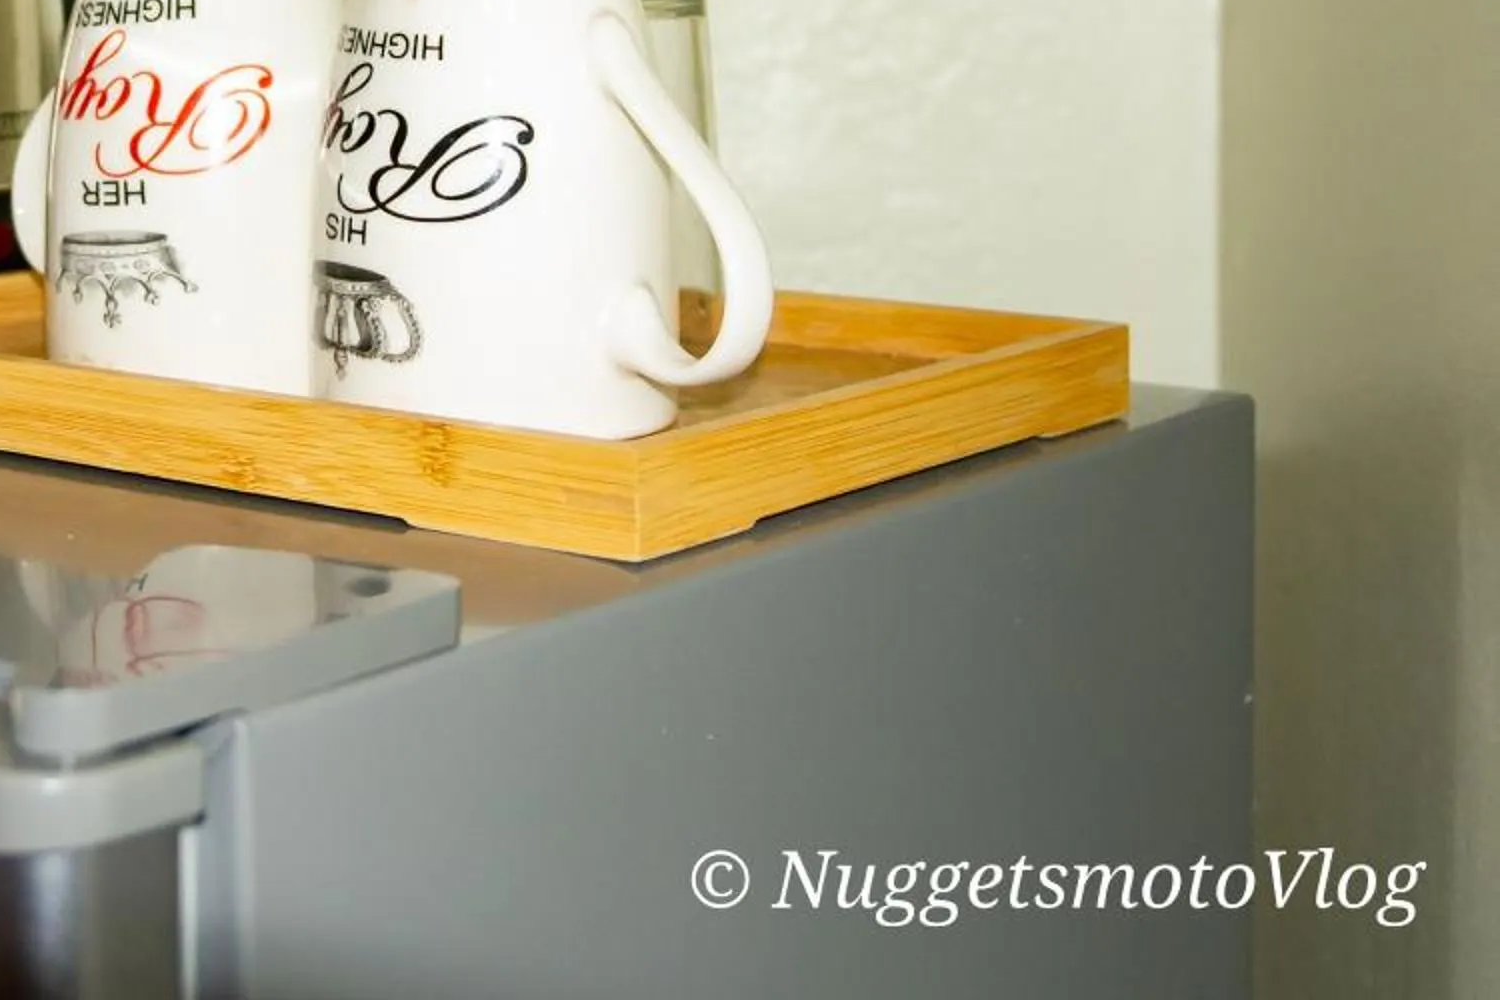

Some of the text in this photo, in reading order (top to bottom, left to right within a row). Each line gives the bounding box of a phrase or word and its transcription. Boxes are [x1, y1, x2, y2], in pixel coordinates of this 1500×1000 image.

[59, 28, 274, 179] Roy
[323, 62, 536, 223] Roy
[82, 180, 147, 206] HER
[325, 213, 367, 246] HIS
